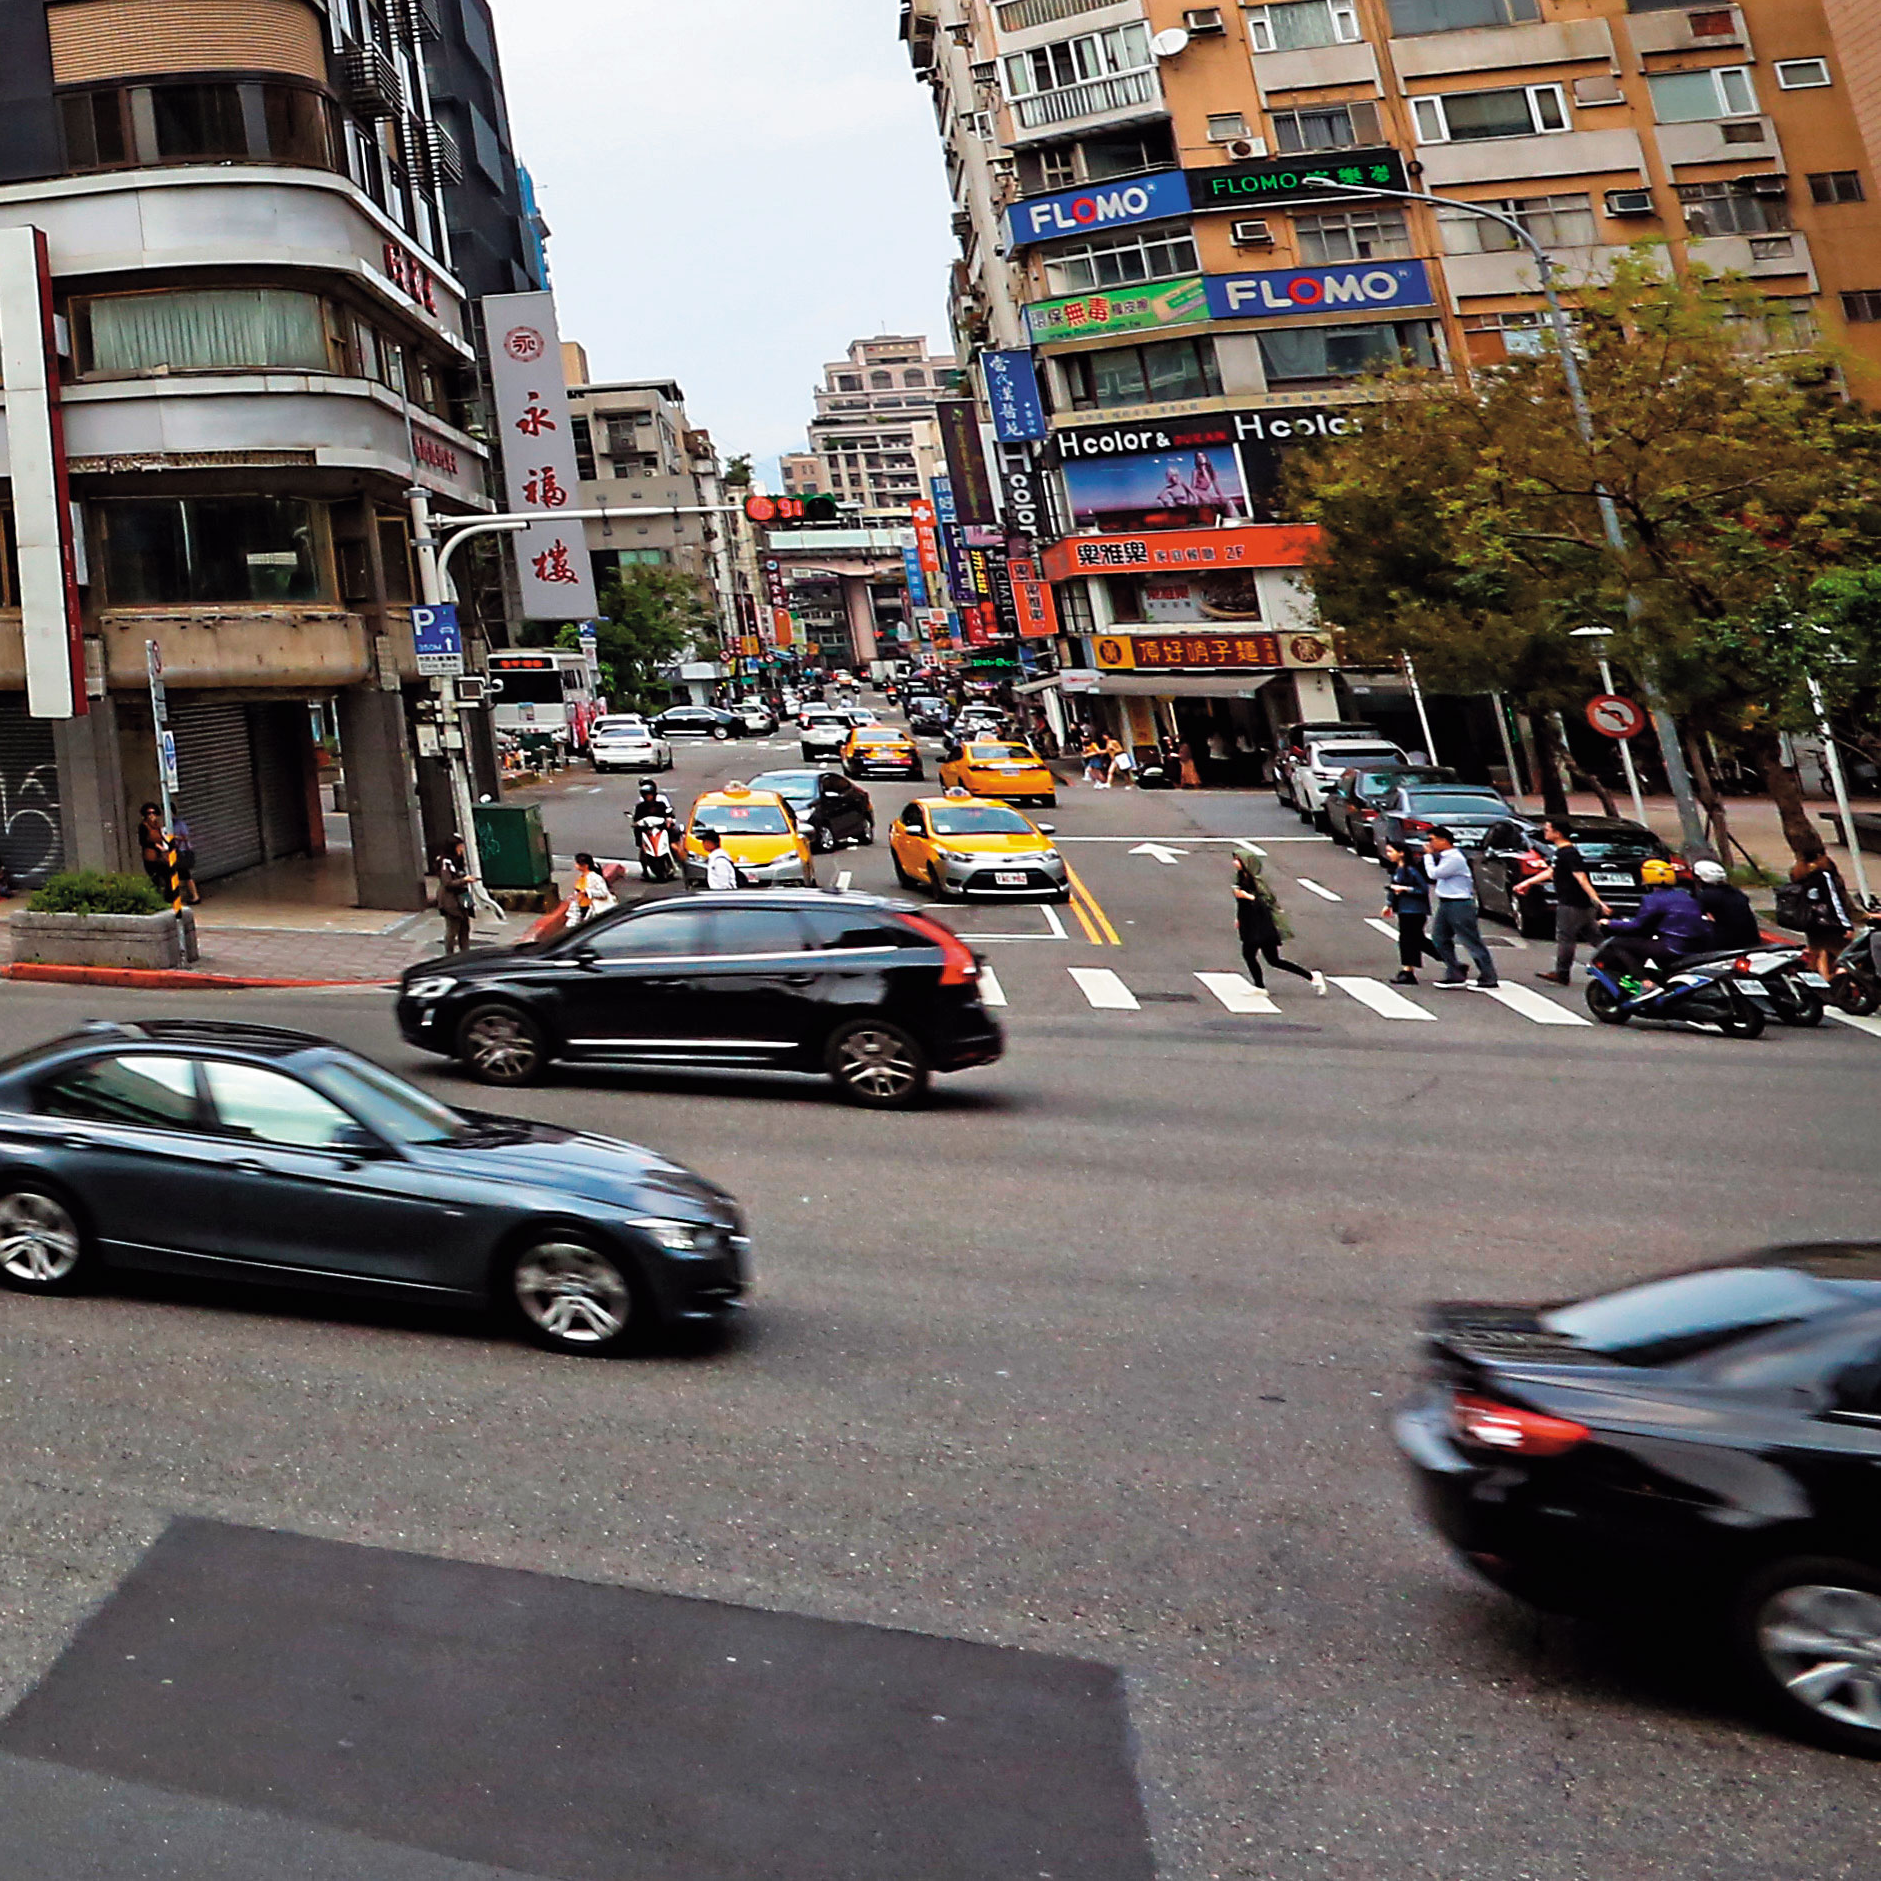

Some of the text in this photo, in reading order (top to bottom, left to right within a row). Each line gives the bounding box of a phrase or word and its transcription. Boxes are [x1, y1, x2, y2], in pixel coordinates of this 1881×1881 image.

[1212, 173, 1298, 195] FLOMO
[1029, 187, 1148, 234] FLOMO
[1225, 269, 1399, 310] FLOMO
[1082, 430, 1151, 454] color
[515, 392, 580, 585] 永福樓
[1009, 474, 1038, 539] color
[1224, 545, 1245, 560] 2F
[412, 609, 435, 637] P
[579, 623, 589, 634] P
